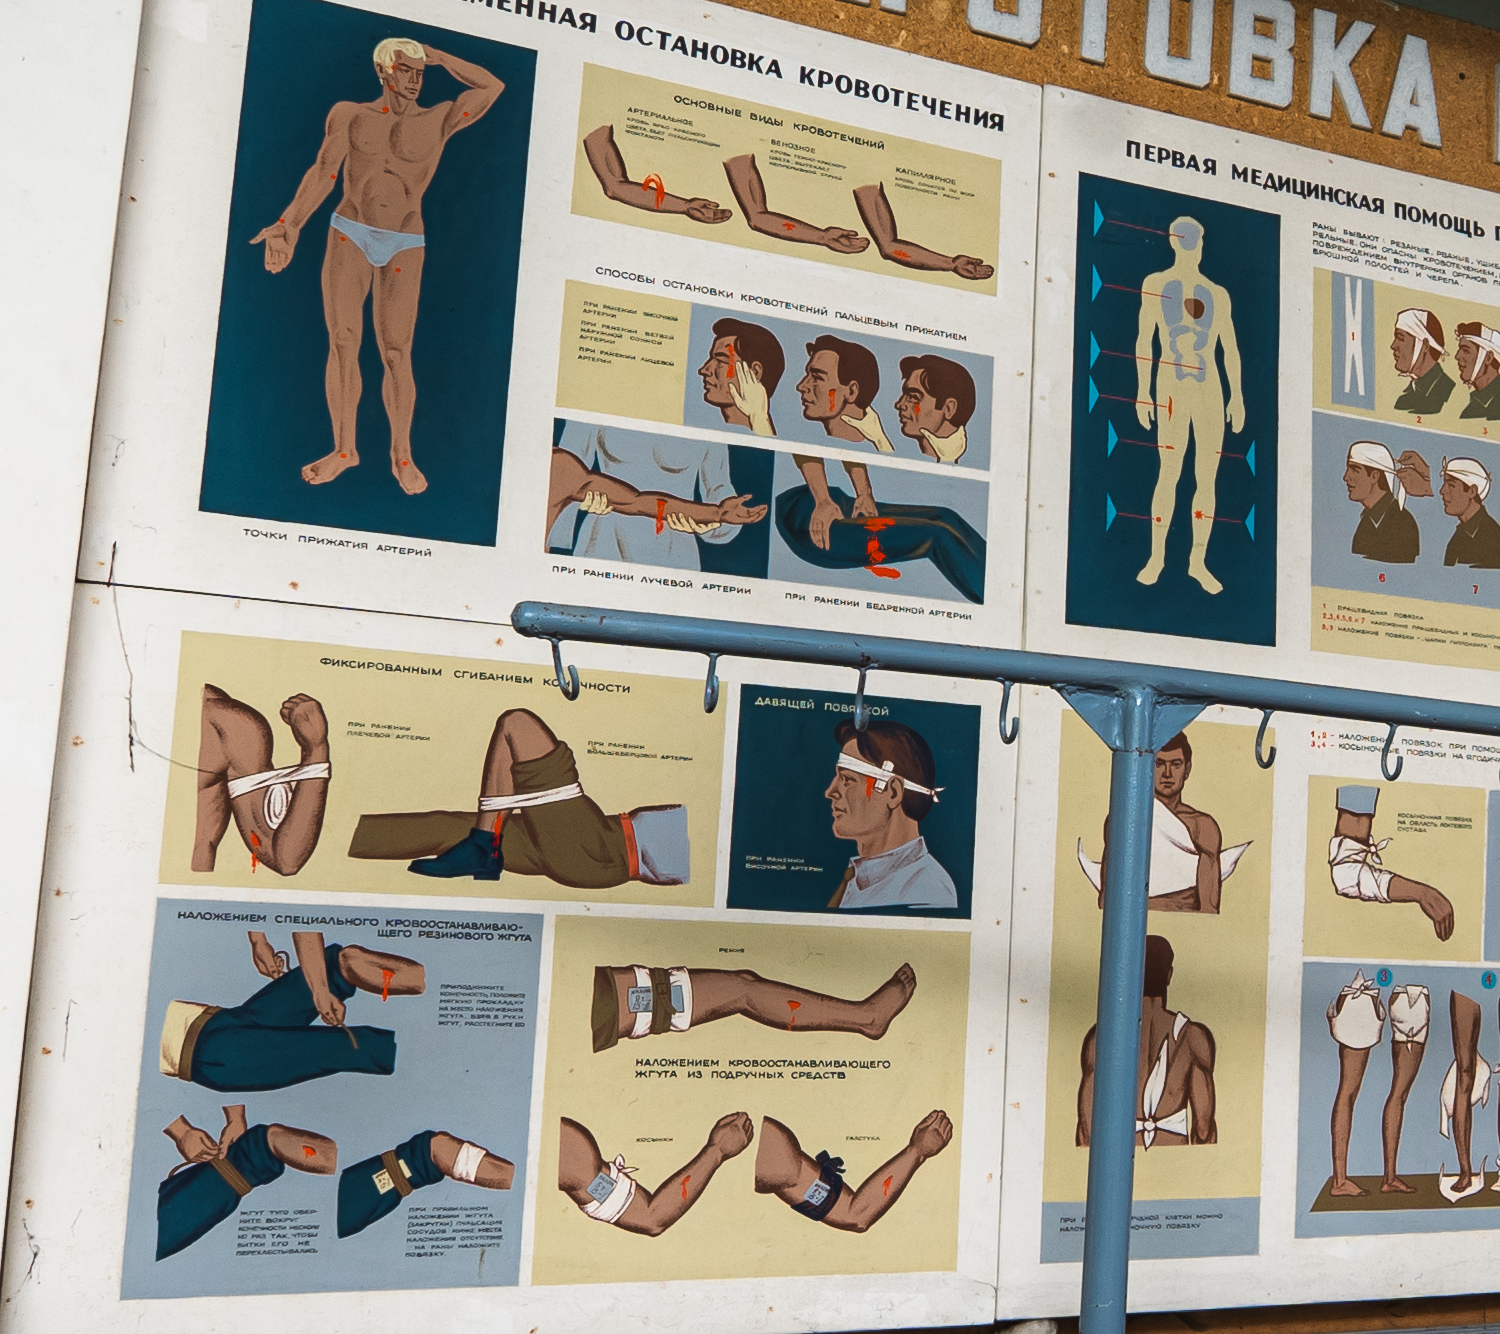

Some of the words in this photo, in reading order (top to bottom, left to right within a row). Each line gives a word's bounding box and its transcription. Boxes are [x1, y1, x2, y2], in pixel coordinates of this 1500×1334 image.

[615, 21, 782, 78] ОСТАНОВКА
[800, 66, 1004, 131] КРОВОТЕЧЕНИЯ
[673, 95, 742, 118] ОСНОВНЫЕ
[749, 112, 784, 127] ВИДЫ
[793, 122, 885, 151] КРОВОТЕЧЕНИЙ
[1126, 139, 1217, 176] ПЕРВАЯ
[1232, 164, 1384, 214] МЕДИЦИНСКАЯ
[1393, 201, 1486, 239] ПОМОЩЬ
[595, 266, 656, 285] СПОСОБЫ
[662, 279, 734, 299] ОСТАНОВКИ
[740, 293, 828, 317] КРОВОТЕЧЕНИЙ
[834, 311, 899, 330] ПАЛЬЦЕВЫМ
[904, 323, 967, 342] ПРИЖАТИЕМ
[242, 528, 288, 541] ТОЧКИ
[298, 535, 369, 550] ПРИЖАТИЯ
[376, 544, 432, 557] АРТЕРИЙ
[552, 565, 576, 575] ПРИ
[583, 568, 634, 582] РАНЕНИИ
[640, 576, 693, 589] ЛУЧЕВОЙ
[701, 583, 752, 595] АРТЕРИИ
[784, 592, 806, 602] ПРИ
[814, 595, 860, 608] РАНЕНИИ
[866, 601, 925, 615] БЕДРЕННОЙ
[928, 609, 972, 621] АРТЕРИИ
[319, 657, 443, 677] ФИКСИРОВАННЫМ
[453, 669, 533, 684] СГИБАНИЕМ
[542, 677, 632, 694] КОЧНОСТИ
[754, 696, 815, 710] ДАВЯЩЕЙ
[177, 911, 267, 923] НАЛОЖЕНИЕМ
[274, 914, 380, 927] СПЕЦИАЛЬНОГО
[385, 918, 524, 932] КРОВООСТАНАВЛИВАЮ-
[377, 929, 413, 939] ЩЕГО
[417, 930, 495, 942] РЕЗИНОВОГО
[496, 933, 533, 943] ЖГУТА
[634, 1069, 678, 1079] ЖГУТА
[687, 1070, 703, 1079] ИЗ
[711, 1070, 785, 1080] ПОДРУЧНЫХ
[790, 1071, 847, 1081] СРЕДСТВ
[635, 1058, 720, 1068] НАЛОЖЕНИЕМ
[728, 1059, 891, 1070] КРОВООСТАНАВЛИВАЮЩЕГО
